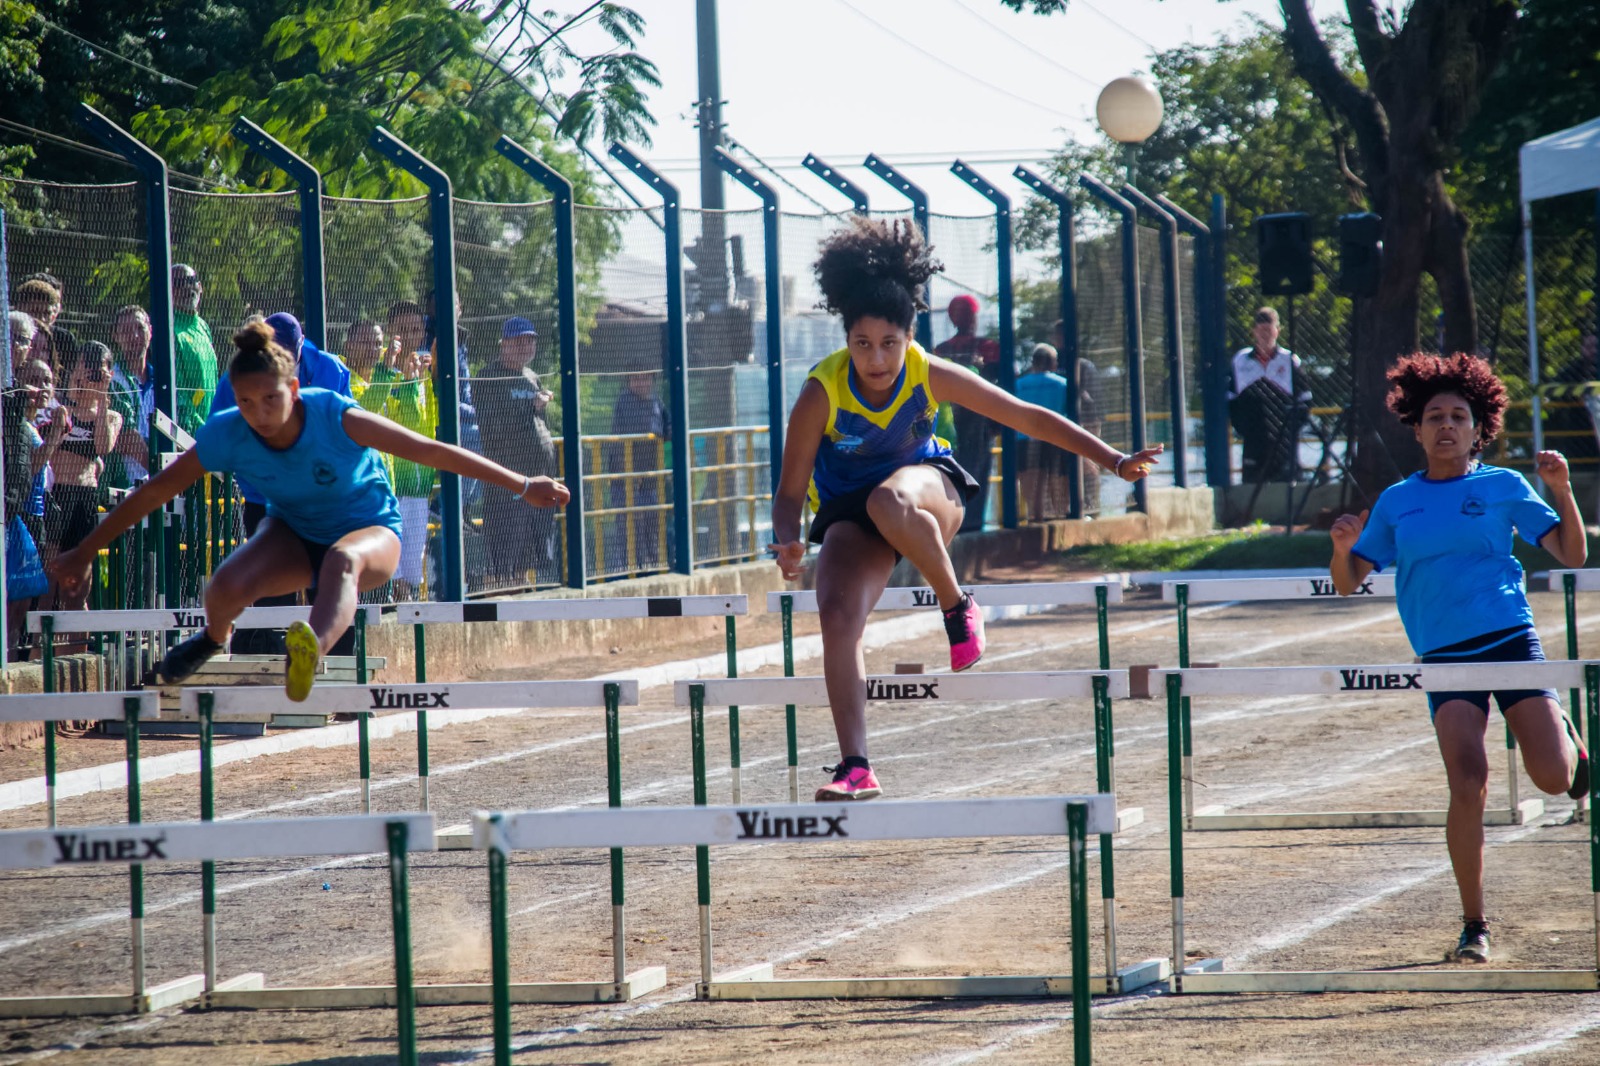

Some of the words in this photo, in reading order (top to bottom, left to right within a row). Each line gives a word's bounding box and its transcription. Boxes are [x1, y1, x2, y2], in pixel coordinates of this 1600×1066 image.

[1310, 579, 1374, 596] Vix
[173, 611, 206, 628] Vin
[1340, 669, 1422, 690] Vinex
[370, 688, 450, 709] Vinex
[736, 811, 849, 839] Vinex
[54, 834, 167, 863] Vinex
